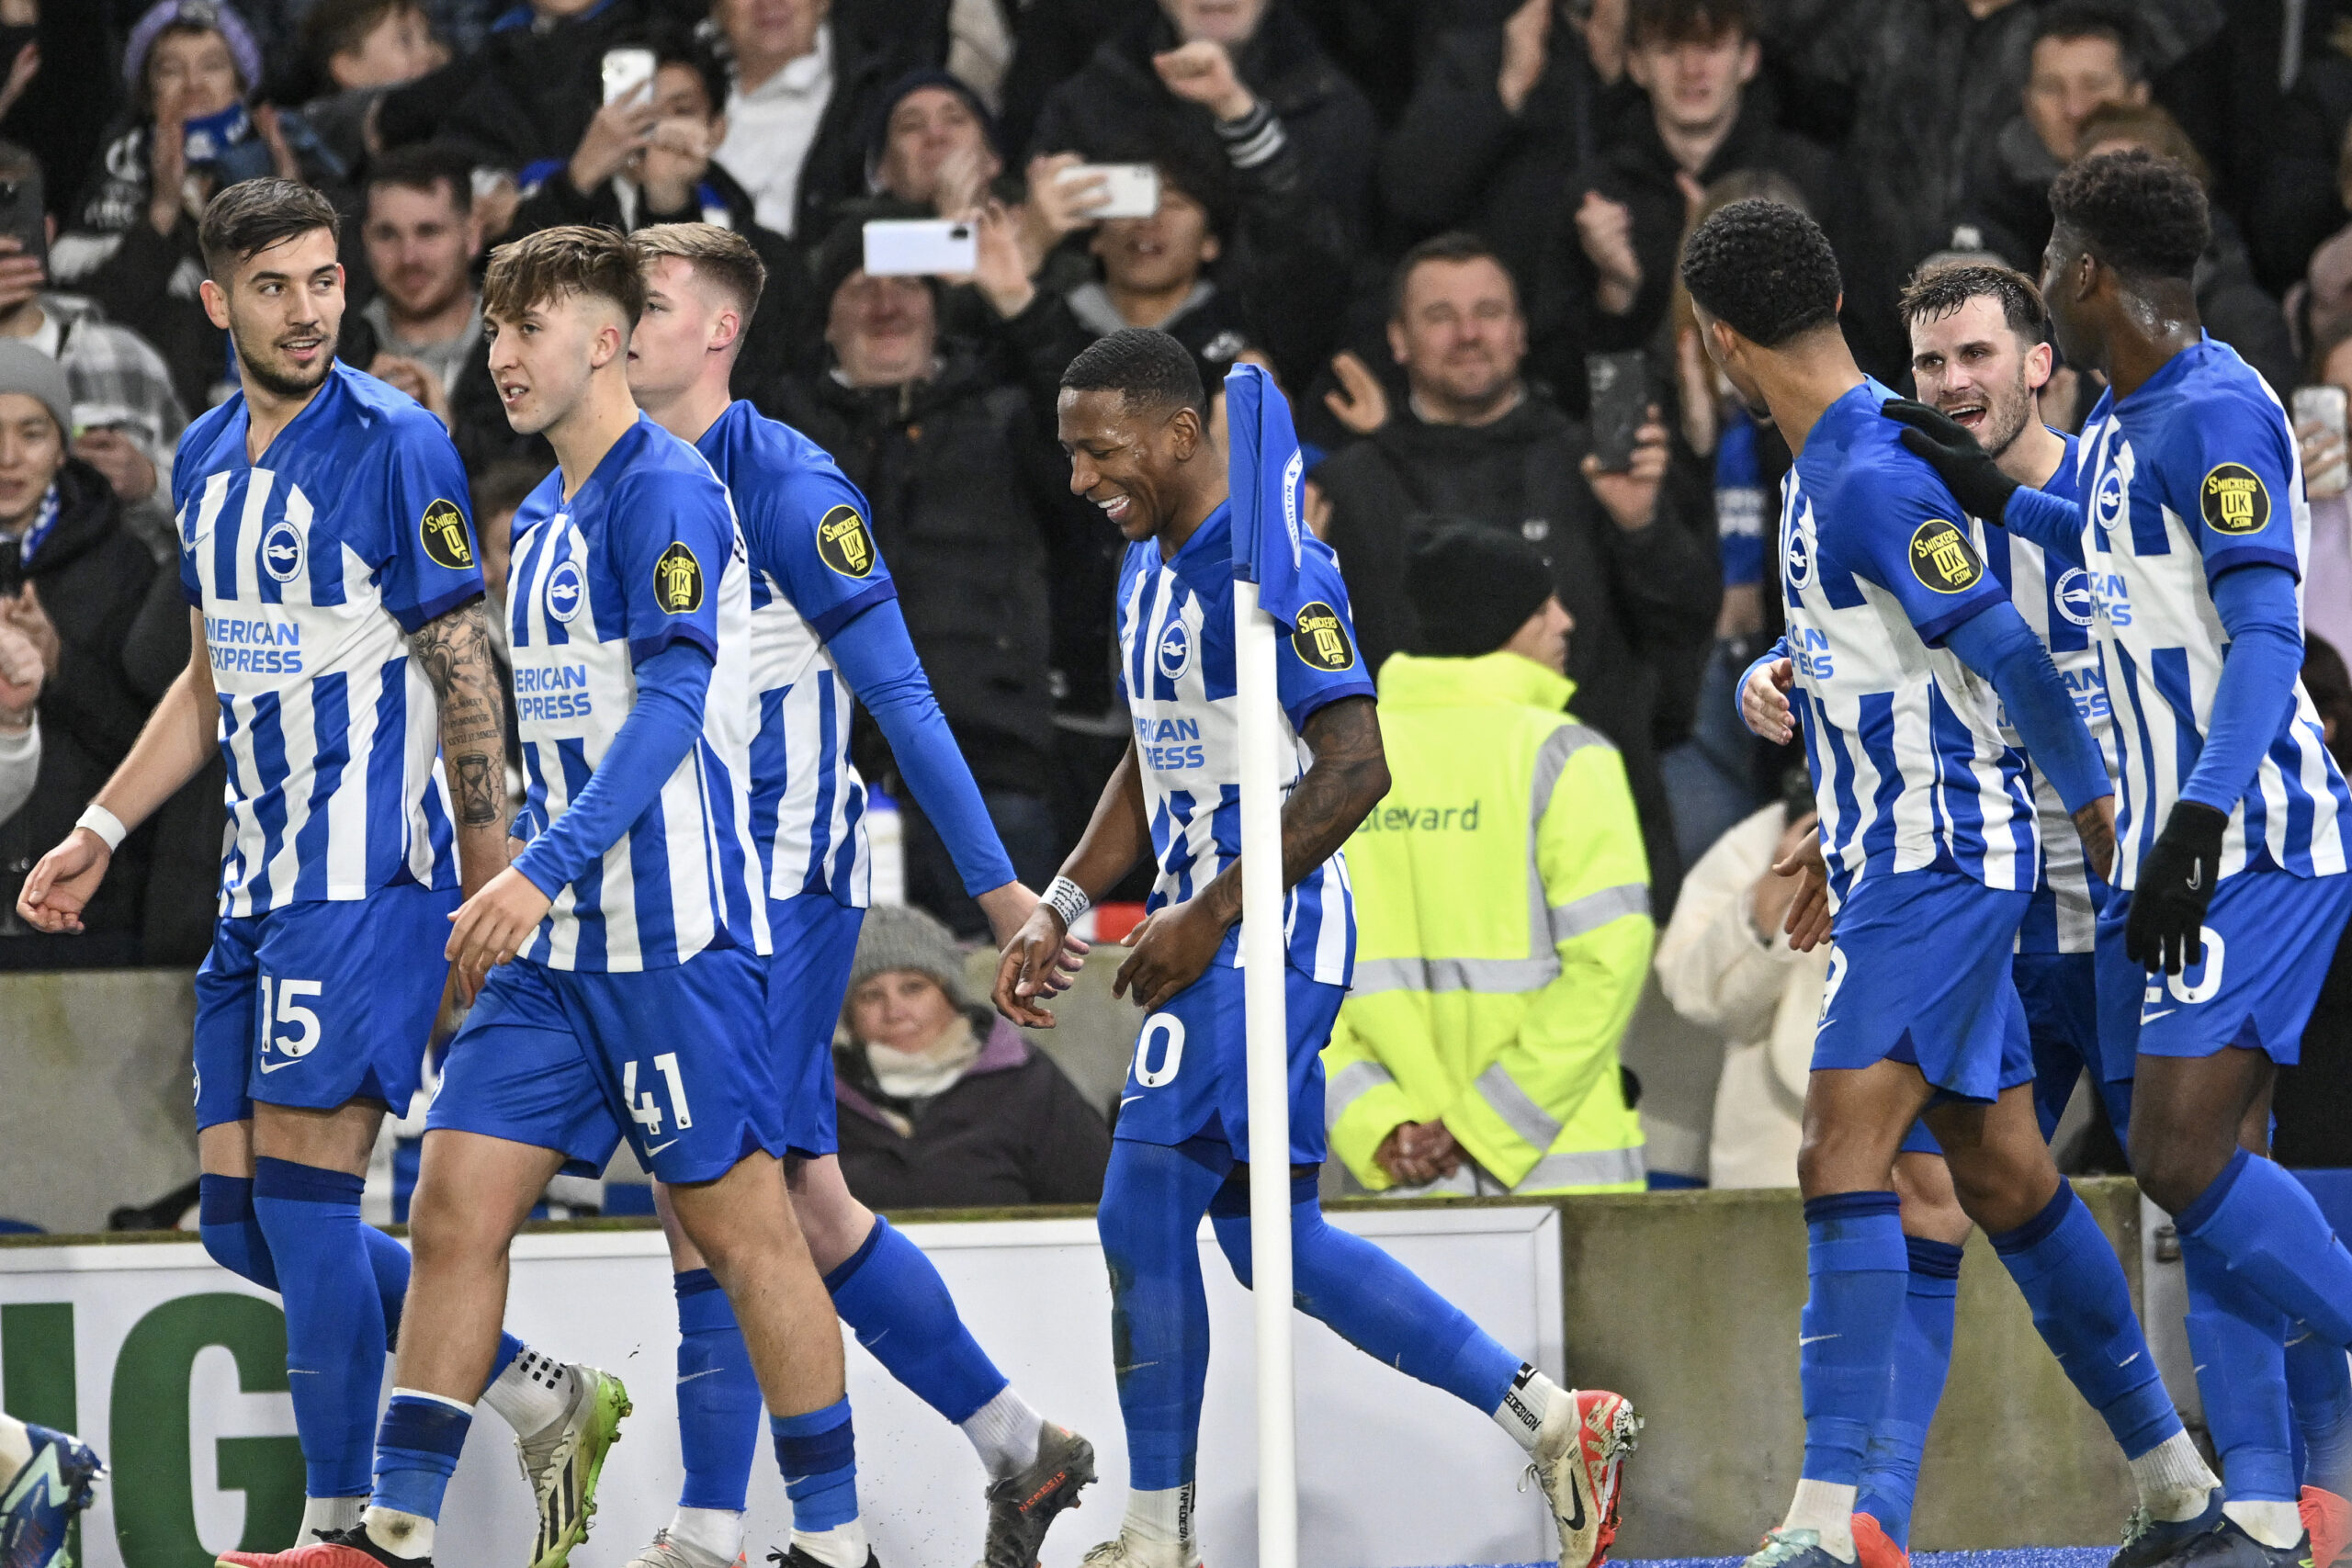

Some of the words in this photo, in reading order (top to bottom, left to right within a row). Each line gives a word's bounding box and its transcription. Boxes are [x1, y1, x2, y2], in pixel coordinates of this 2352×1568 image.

[2225, 493, 2248, 513] UK
[842, 533, 862, 558] UK
[1914, 529, 1960, 558] SNICKERS
[1937, 547, 1964, 573] UK
[1953, 568, 1973, 586] .COM
[2059, 568, 2083, 585] BRIGHTO
[204, 616, 300, 647] MERICAN
[1318, 631, 1340, 652] UK
[514, 663, 586, 694] ERICAN
[1144, 745, 1205, 771] RESS
[261, 975, 322, 1057] 15
[1135, 1012, 1186, 1089] 0
[623, 1052, 693, 1135] 41
[1504, 1391, 1543, 1432] EDESIGN
[1178, 1483, 1191, 1541] TAPEDESI
